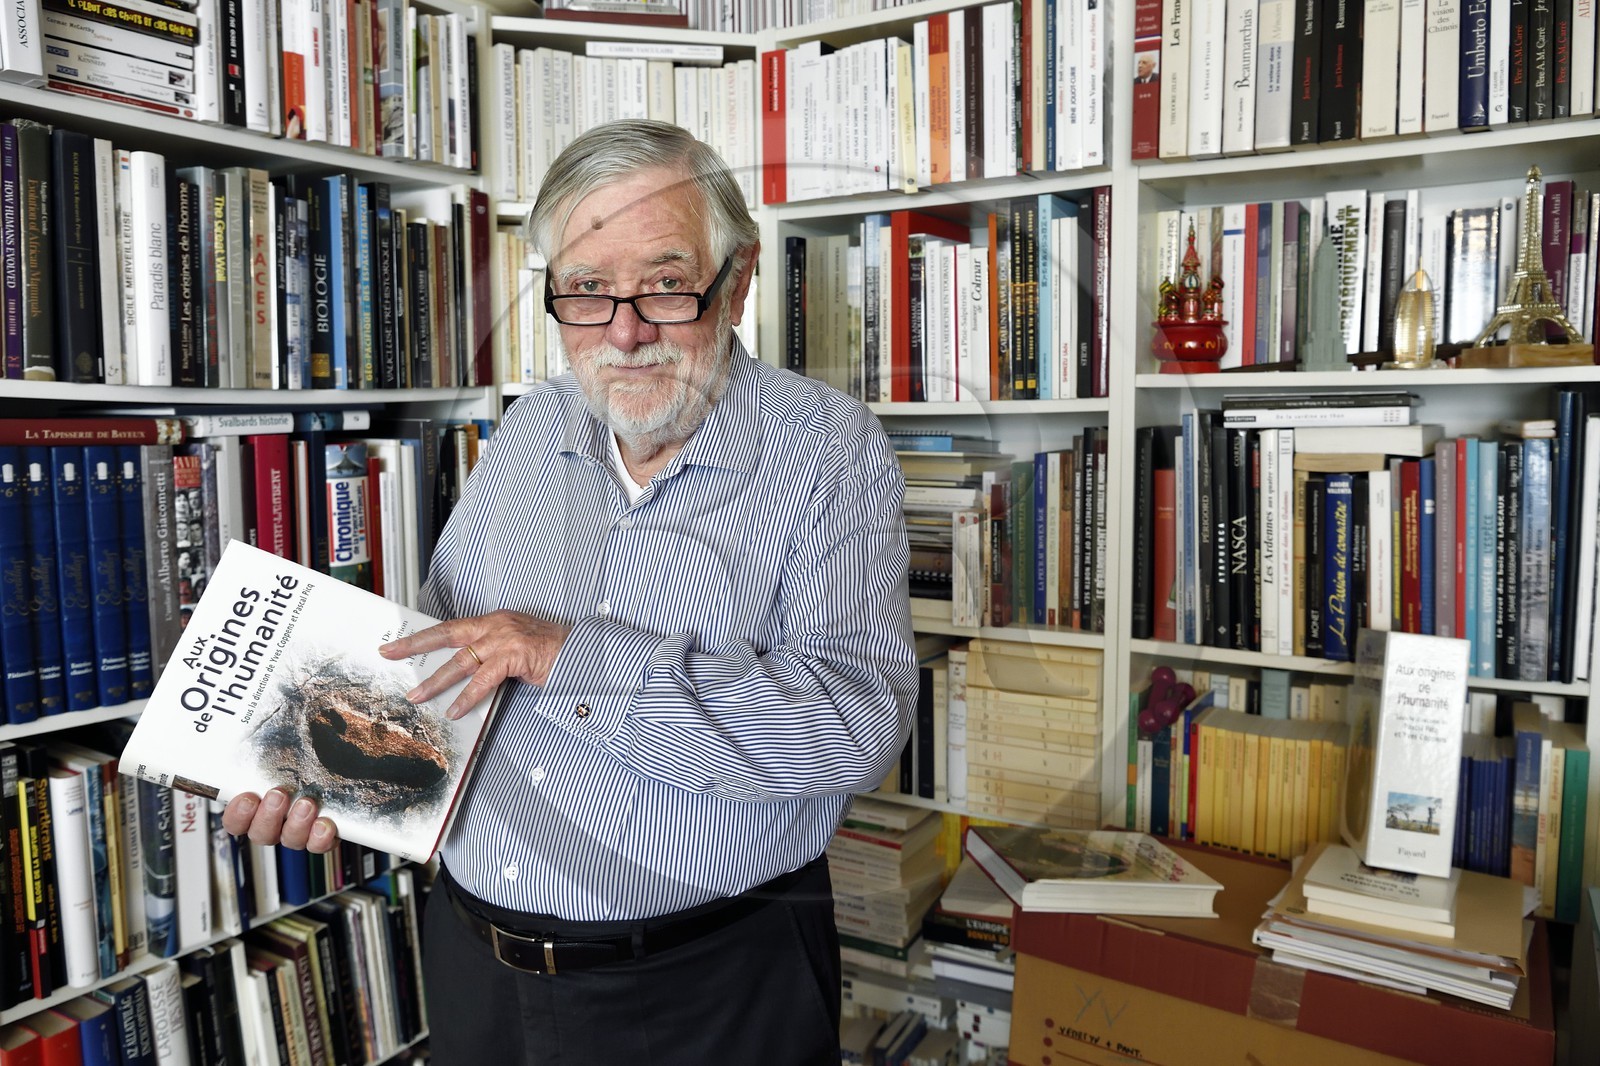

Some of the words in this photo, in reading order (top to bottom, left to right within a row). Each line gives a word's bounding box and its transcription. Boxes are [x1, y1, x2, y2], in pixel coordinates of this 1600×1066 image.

[18, 0, 29, 49] ASSOCIA
[1432, 7, 1455, 16] vision
[1437, 16, 1449, 24] des
[69, 22, 94, 33] McCarthy
[1428, 23, 1458, 34] Chinois
[1234, 9, 1253, 88] Beaumarchais
[1467, 18, 1487, 79] Umberto
[4, 181, 14, 203] HOW
[28, 179, 38, 220] Evolution
[1549, 193, 1560, 215] Attali
[178, 182, 189, 233] l'homme
[215, 196, 225, 218] The
[1096, 194, 1106, 238] DÉCORATION
[1335, 209, 1345, 221] du
[5, 205, 15, 245] HUMANS
[29, 222, 39, 232] of
[214, 220, 226, 253] Great
[1550, 218, 1560, 245] Jacques
[29, 234, 40, 267] African
[122, 210, 134, 288] MERVEILLEUSE
[148, 223, 162, 258] blanc
[179, 236, 189, 251] de
[1390, 229, 1399, 269] Normandie
[6, 248, 16, 288] EVOLVED
[181, 254, 193, 299] origines
[217, 257, 226, 281] Wall
[971, 259, 982, 301] Colmar
[1097, 258, 1105, 297] BRICOLAGE
[29, 271, 41, 318] Mammals
[150, 263, 165, 310] Paradis
[314, 254, 329, 332] BIOLOGIE
[1571, 255, 1581, 314] Culture-monde
[126, 294, 135, 325] SICILE
[181, 302, 192, 320] Les
[976, 305, 982, 313] de
[960, 348, 968, 358] La
[1085, 454, 1093, 466] THE
[351, 505, 357, 513] et
[1085, 468, 1093, 524] SABER-TOOTHED
[333, 481, 352, 562] Chronique
[1329, 500, 1348, 552] connaître
[1482, 514, 1494, 553] L'ESPÈCE
[353, 546, 360, 555] de
[1085, 541, 1091, 550] OF
[1232, 516, 1248, 575] NASCA
[1262, 512, 1273, 563] Ardennes
[1497, 541, 1504, 552] de
[1218, 523, 1226, 583] ATAPUERCA
[1329, 554, 1346, 568] de
[1483, 557, 1492, 569] DE
[1263, 566, 1274, 584] Les
[1353, 563, 1360, 571] La
[303, 583, 315, 600] Picq
[1253, 584, 1261, 607] origines
[1328, 571, 1348, 614] Passion
[1481, 571, 1493, 613] L'ODYSSÉE
[291, 613, 298, 623] et
[293, 595, 307, 620] Pascal
[277, 623, 295, 650] Coppens
[382, 630, 392, 642] De
[1311, 610, 1320, 638] MONET
[1331, 617, 1348, 645] La
[1497, 629, 1503, 638] Le
[180, 586, 260, 712] Origines
[183, 636, 208, 670] Aux
[193, 712, 213, 733] de
[211, 574, 299, 716] l'humanité
[269, 647, 283, 667] Yves
[268, 659, 278, 673] de
[1396, 664, 1415, 676] Aux
[1418, 668, 1456, 683] origines
[255, 667, 271, 701] direction
[1418, 684, 1431, 694] de
[241, 704, 255, 724] Sous
[250, 697, 258, 708] la
[1397, 692, 1449, 710] l'humanité
[36, 778, 53, 861] Swartkrans
[181, 803, 196, 833] Née
[1398, 847, 1426, 858] Fayard
[966, 919, 1008, 934] L'EUROPE
[151, 983, 171, 1059] LAROUSSE
